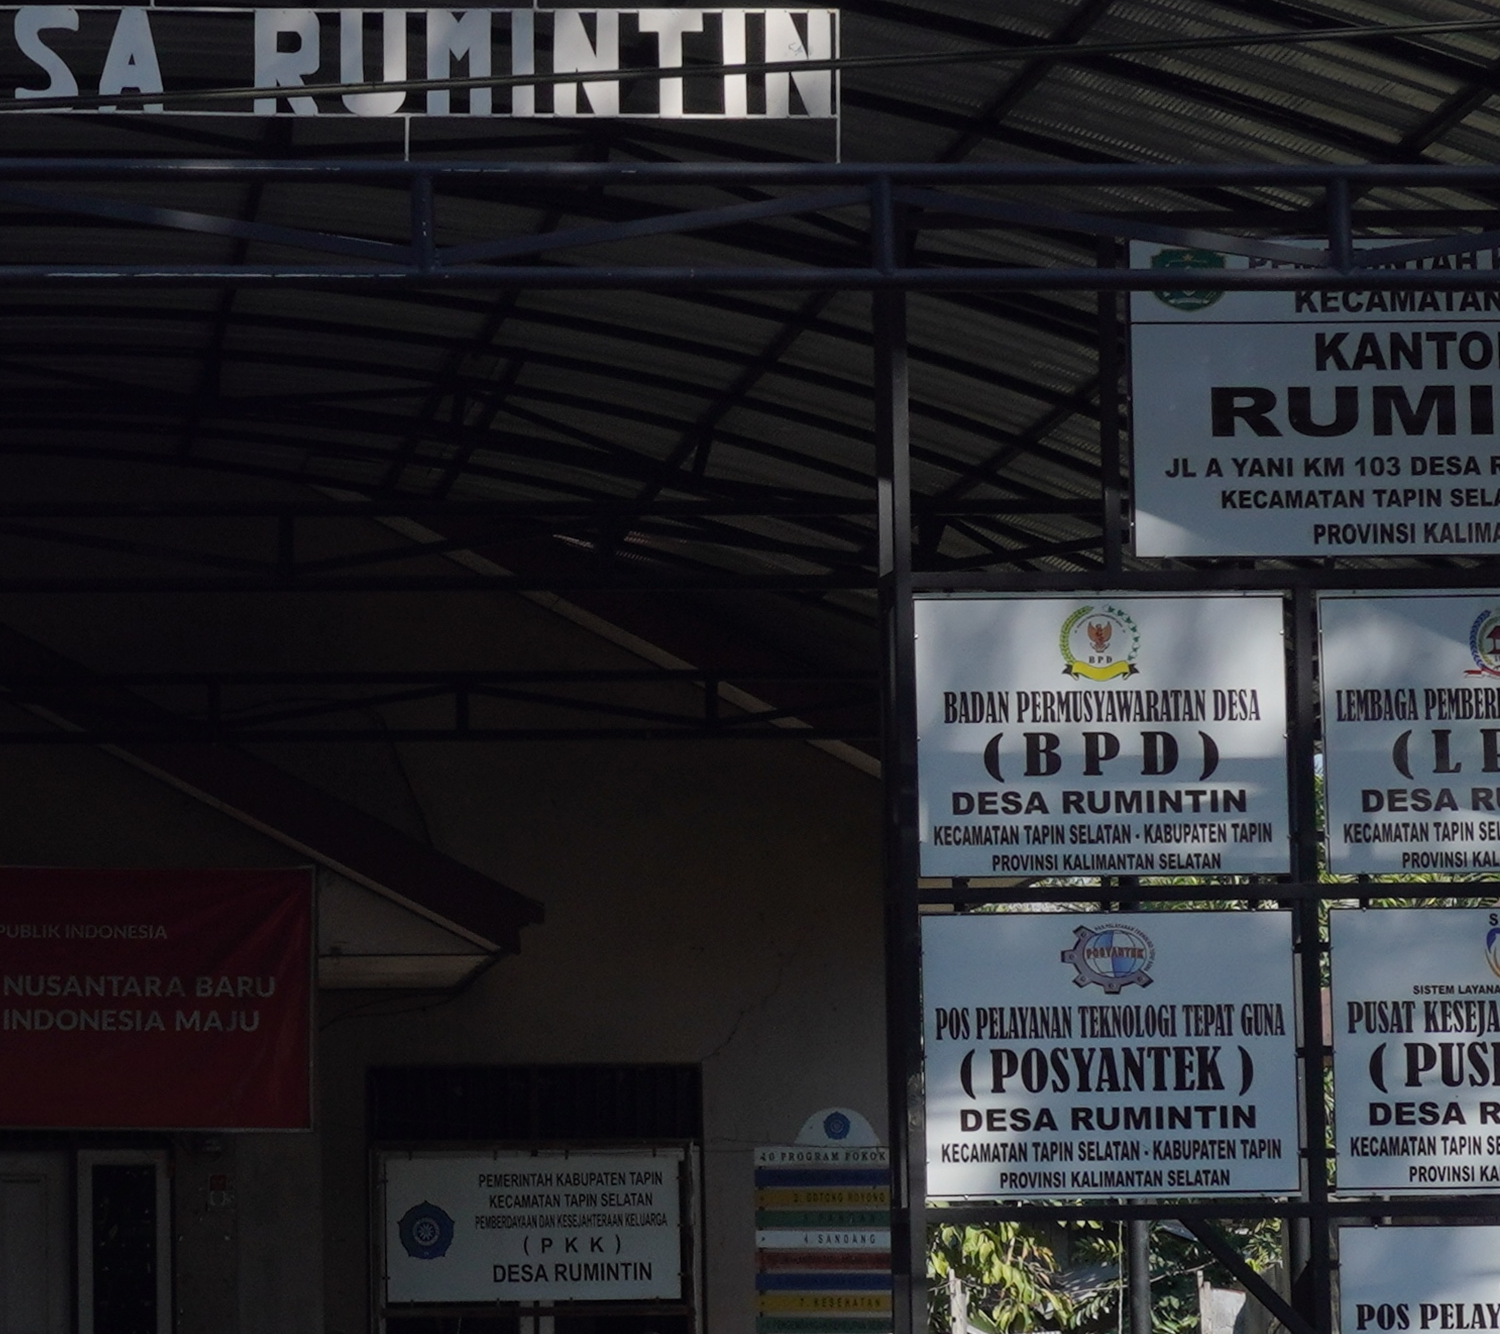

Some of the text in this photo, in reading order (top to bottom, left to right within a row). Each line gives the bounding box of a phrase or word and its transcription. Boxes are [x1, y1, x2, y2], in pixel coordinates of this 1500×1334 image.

[254, 9, 832, 117] RUMINTIN
[1165, 458, 1198, 478] JL
[1205, 458, 1222, 478] A
[1232, 457, 1295, 477] YANI
[1304, 457, 1345, 477] KM
[1355, 456, 1401, 477] 103
[1410, 456, 1481, 476] DESA
[1222, 489, 1364, 509] KECAMATAN
[1373, 488, 1441, 507] TAPIN
[1314, 524, 1415, 545] PROVINSI
[944, 690, 1261, 723] BADAN PERMUSYAWARATAN DESA
[1336, 689, 1418, 722] LEMBAGA
[952, 790, 1246, 814] DESA RUMINTIN
[1362, 788, 1462, 812] DESA
[934, 823, 1272, 846] KECAMATAN TAPIN SELATAN KABUPATEN TAPIN
[65, 925, 167, 939] INDONESIA
[4, 975, 276, 998] NUSANTARA BARU
[1413, 985, 1454, 994] SISTEM
[4, 1009, 260, 1032] INDONESIA MAJU
[936, 1003, 1285, 1040] POS PELAYANAN TEKNOLOGI TEPAT GUNA
[1347, 1001, 1415, 1034] PUSAT
[960, 1105, 1256, 1132] DESA RUMINTIN
[1369, 1102, 1466, 1126] DESA
[942, 1139, 1282, 1163] KECAMATAN TAPIN SELATAN KABUPATEN TAPIN
[479, 1172, 662, 1187] PEMERINTAH KABUPATEN TAPIN
[490, 1193, 652, 1209] KECAMATAN TAPIN SELATAN
[475, 1213, 667, 1229] PEMBERDAYAAN DAN KESEJAHTERAAN KELUARGA
[493, 1263, 651, 1282] DESA RUMINTIN
[1356, 1303, 1410, 1330] POS
